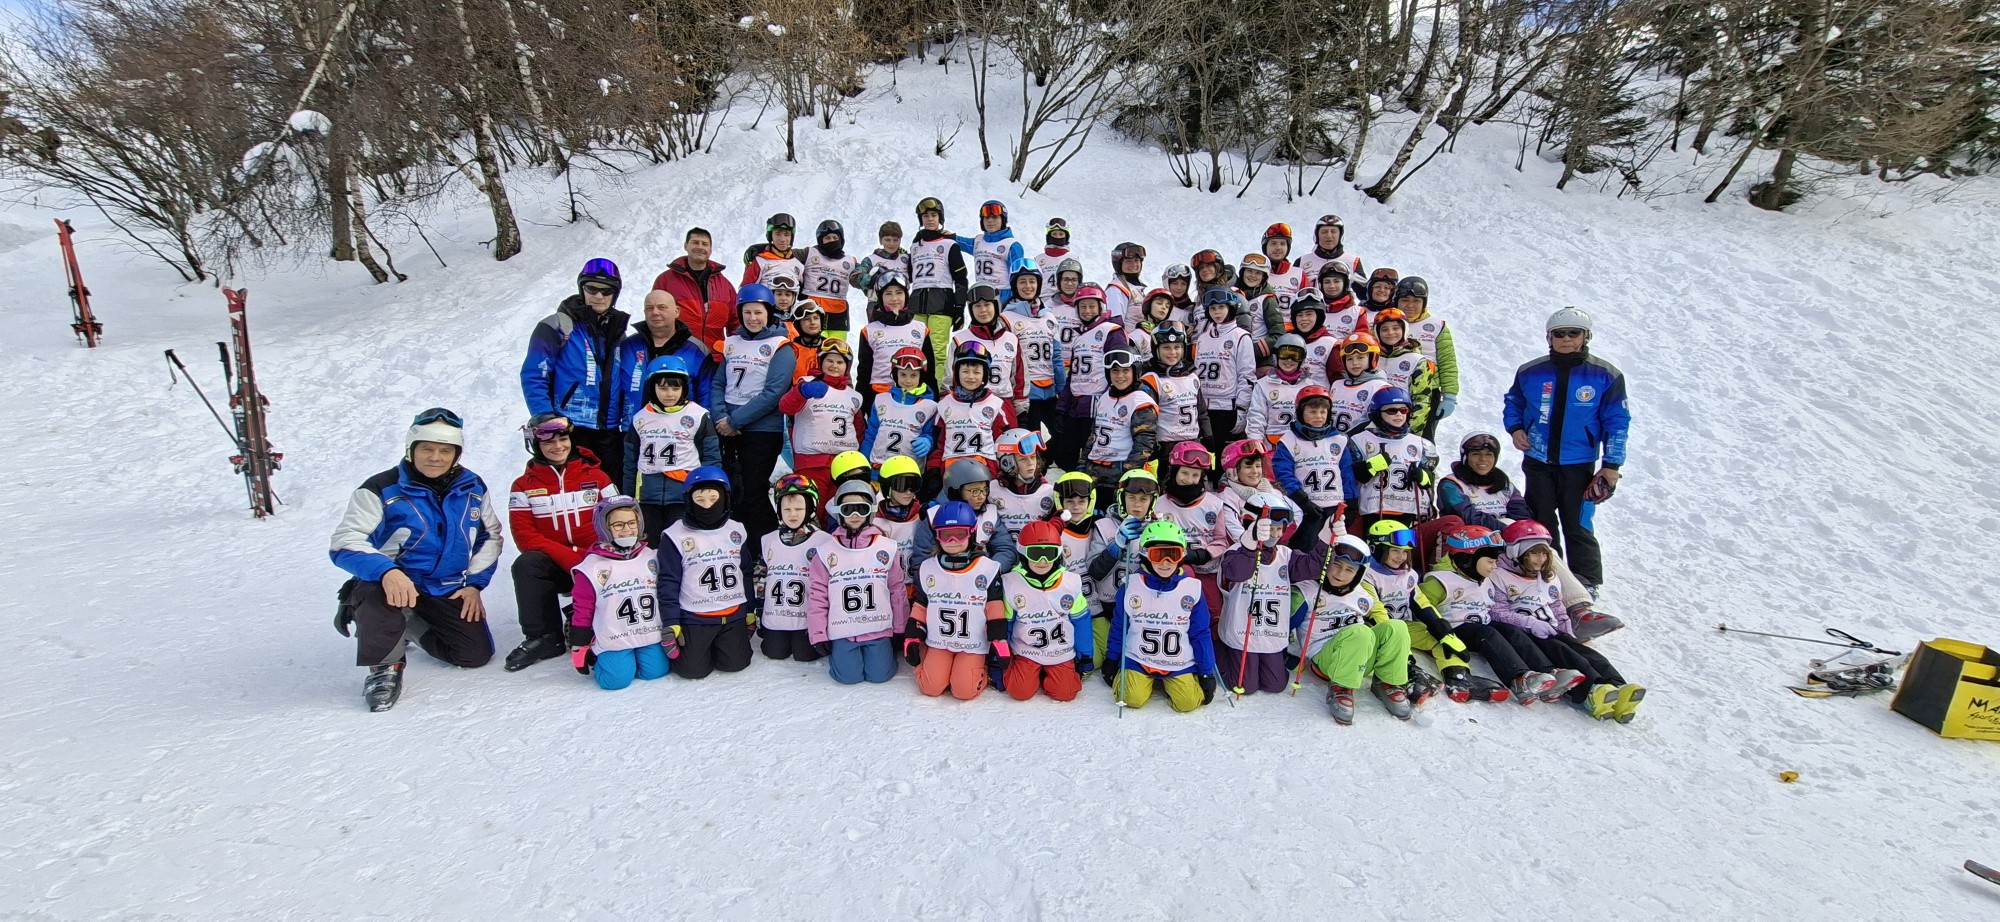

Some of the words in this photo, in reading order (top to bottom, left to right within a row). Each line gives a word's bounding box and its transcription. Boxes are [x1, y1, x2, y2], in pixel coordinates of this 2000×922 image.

[915, 262, 935, 278] 22
[975, 260, 994, 275] 36
[816, 276, 841, 294] 20
[1027, 342, 1052, 361] 38
[1072, 356, 1093, 375] 35
[1198, 362, 1221, 380] 28
[732, 366, 748, 389] 7
[832, 415, 847, 438] 3
[885, 430, 904, 453] 2
[952, 431, 984, 454] 24
[642, 441, 679, 467] 44
[1303, 468, 1337, 493] 42
[1373, 467, 1409, 492] 33
[1463, 537, 1487, 549] NEON
[685, 548, 723, 563] SCUOLA
[600, 577, 639, 596] SCUOLA
[699, 562, 739, 593] 46
[771, 578, 805, 607] 43
[842, 582, 877, 614] 61
[616, 592, 656, 626] 49
[1247, 598, 1281, 628] 45
[938, 607, 971, 639] 51
[1028, 621, 1069, 649] 34
[1139, 626, 1182, 657] 50
